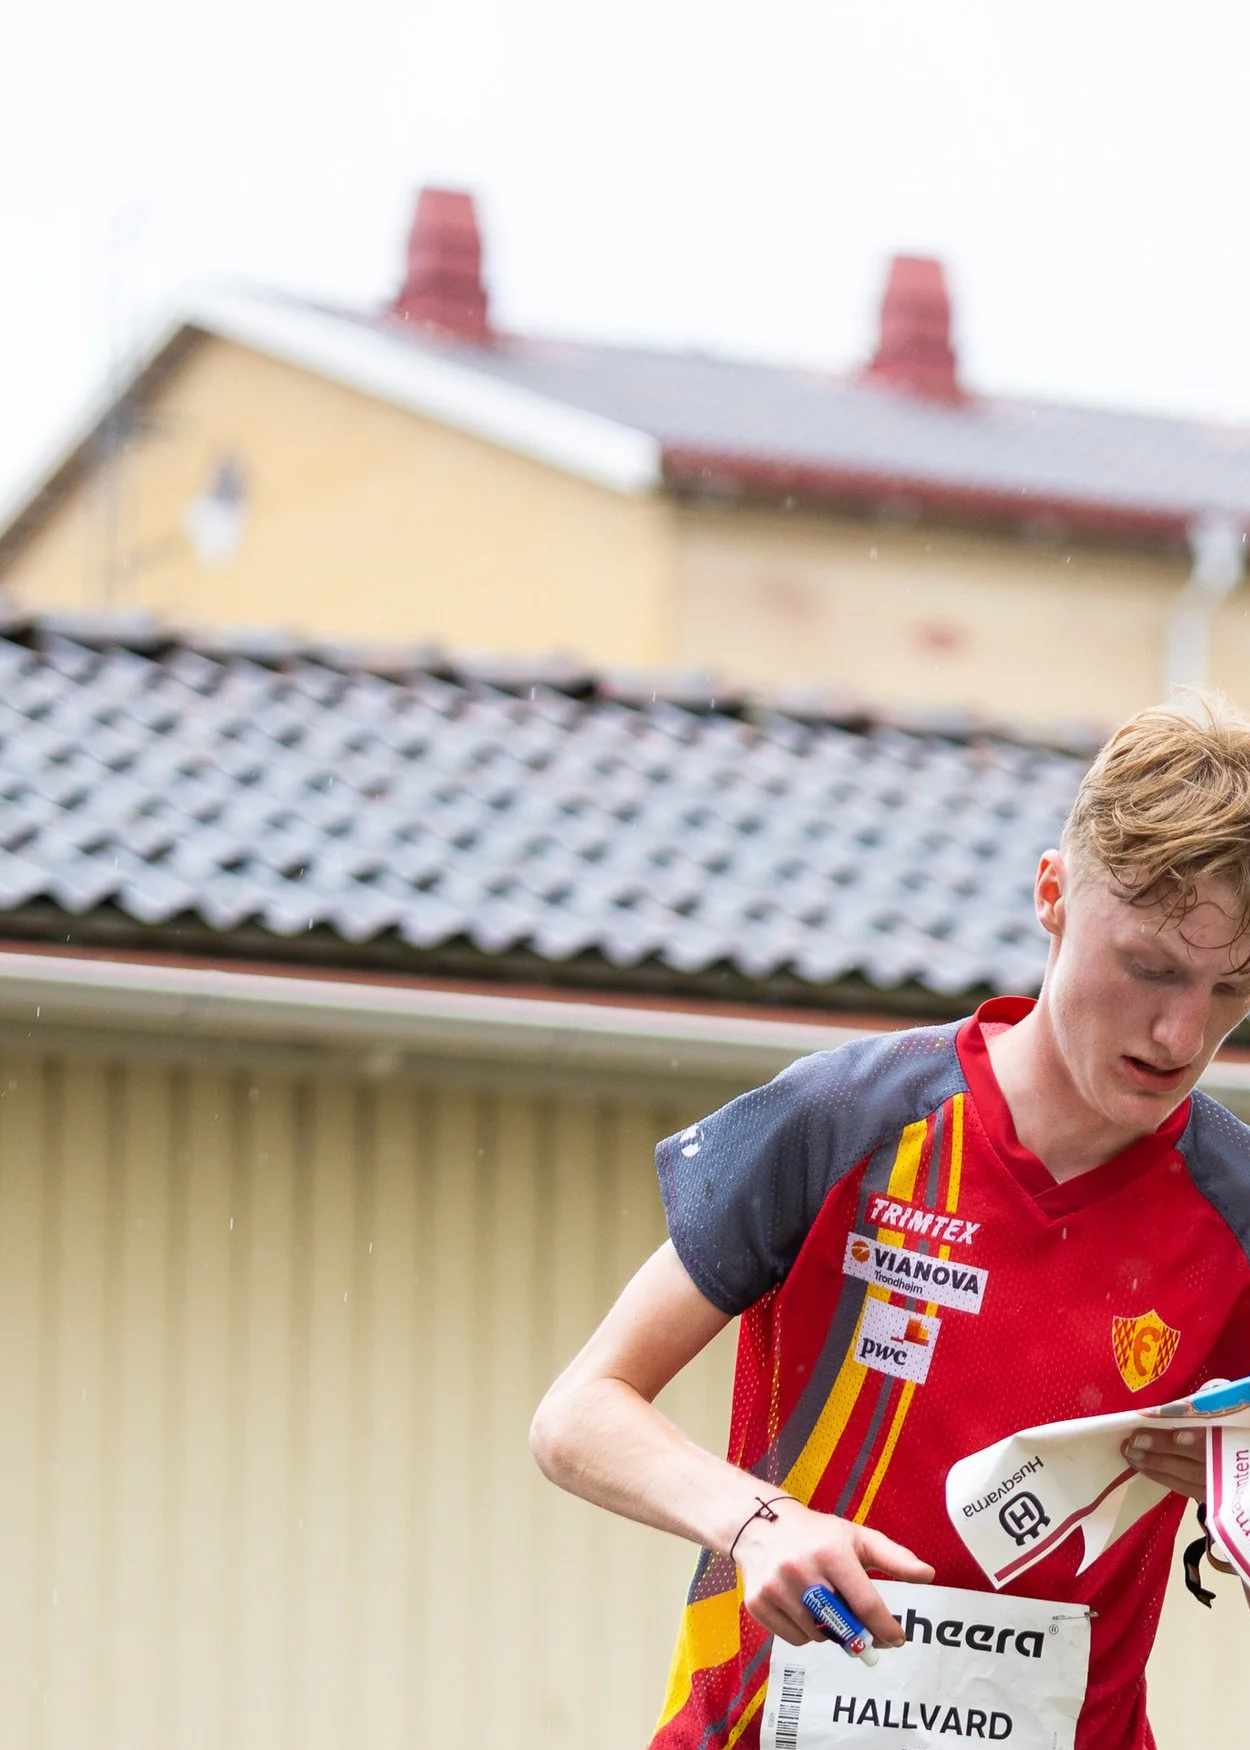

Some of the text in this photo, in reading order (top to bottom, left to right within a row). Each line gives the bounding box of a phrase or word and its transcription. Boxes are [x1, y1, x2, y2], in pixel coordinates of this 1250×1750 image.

[870, 1198, 981, 1245] TRIMTEX
[874, 1247, 979, 1295] VIANOVA
[874, 1271, 924, 1295] Trondheim
[859, 1337, 908, 1366] pwc
[962, 1455, 1045, 1518] Husqvarna
[893, 1608, 1045, 1659] heera
[832, 1695, 1013, 1741] HALLVARD
